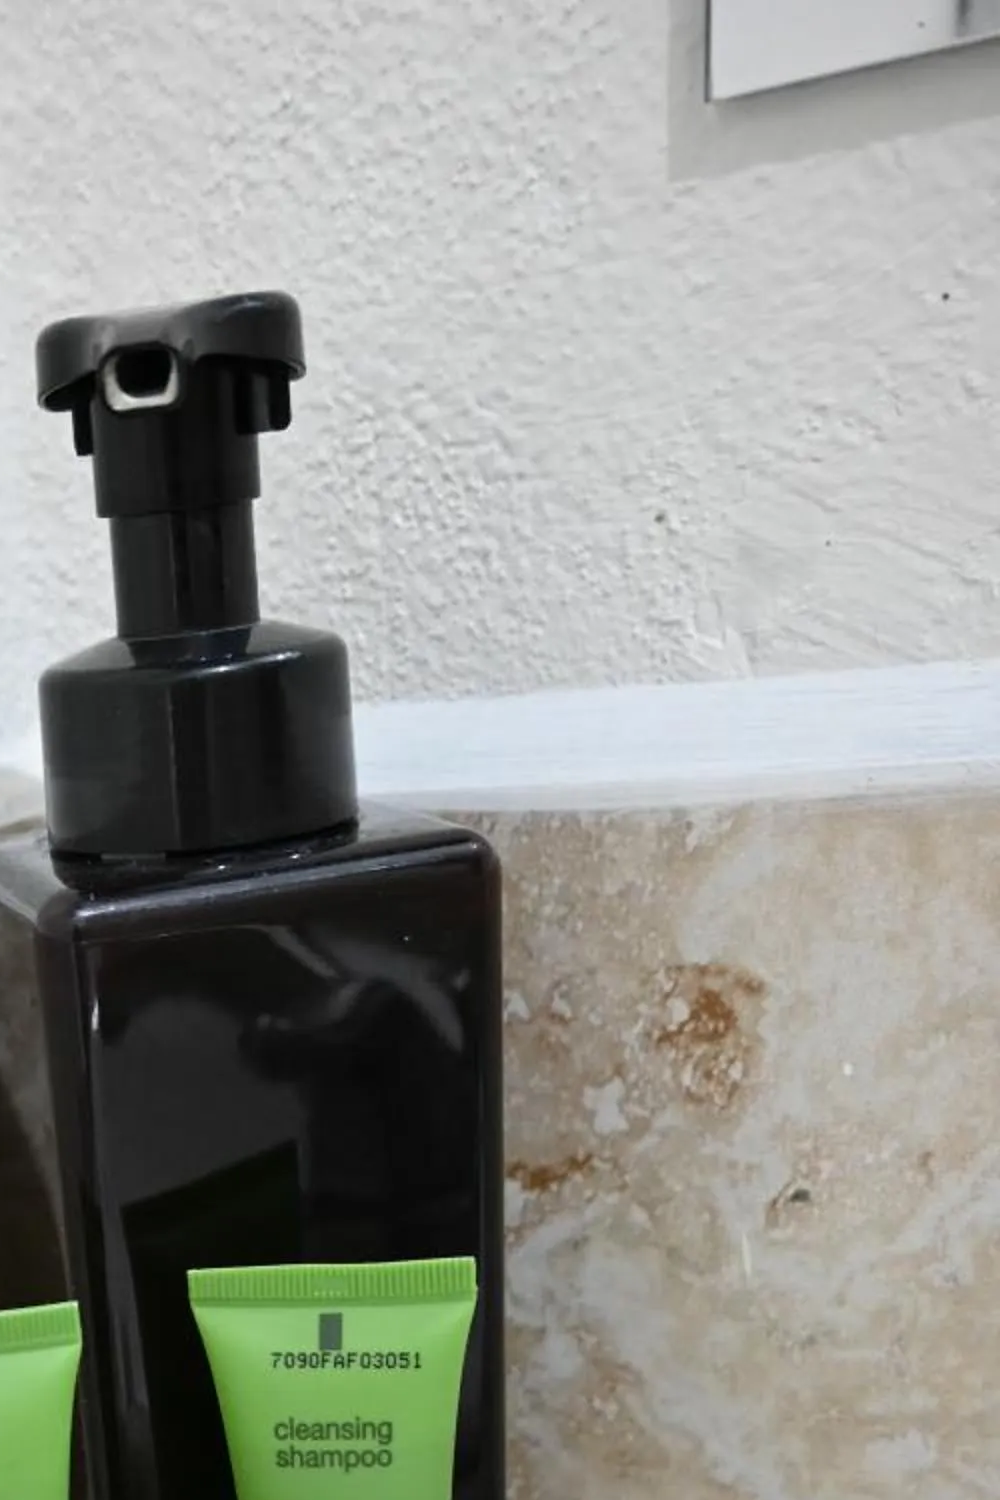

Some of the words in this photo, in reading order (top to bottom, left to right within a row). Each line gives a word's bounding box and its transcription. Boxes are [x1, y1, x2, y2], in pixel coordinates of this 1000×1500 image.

[270, 1352, 423, 1369] 7090FAF03051
[273, 1416, 394, 1446] cleansing
[275, 1445, 393, 1473] shampoo
